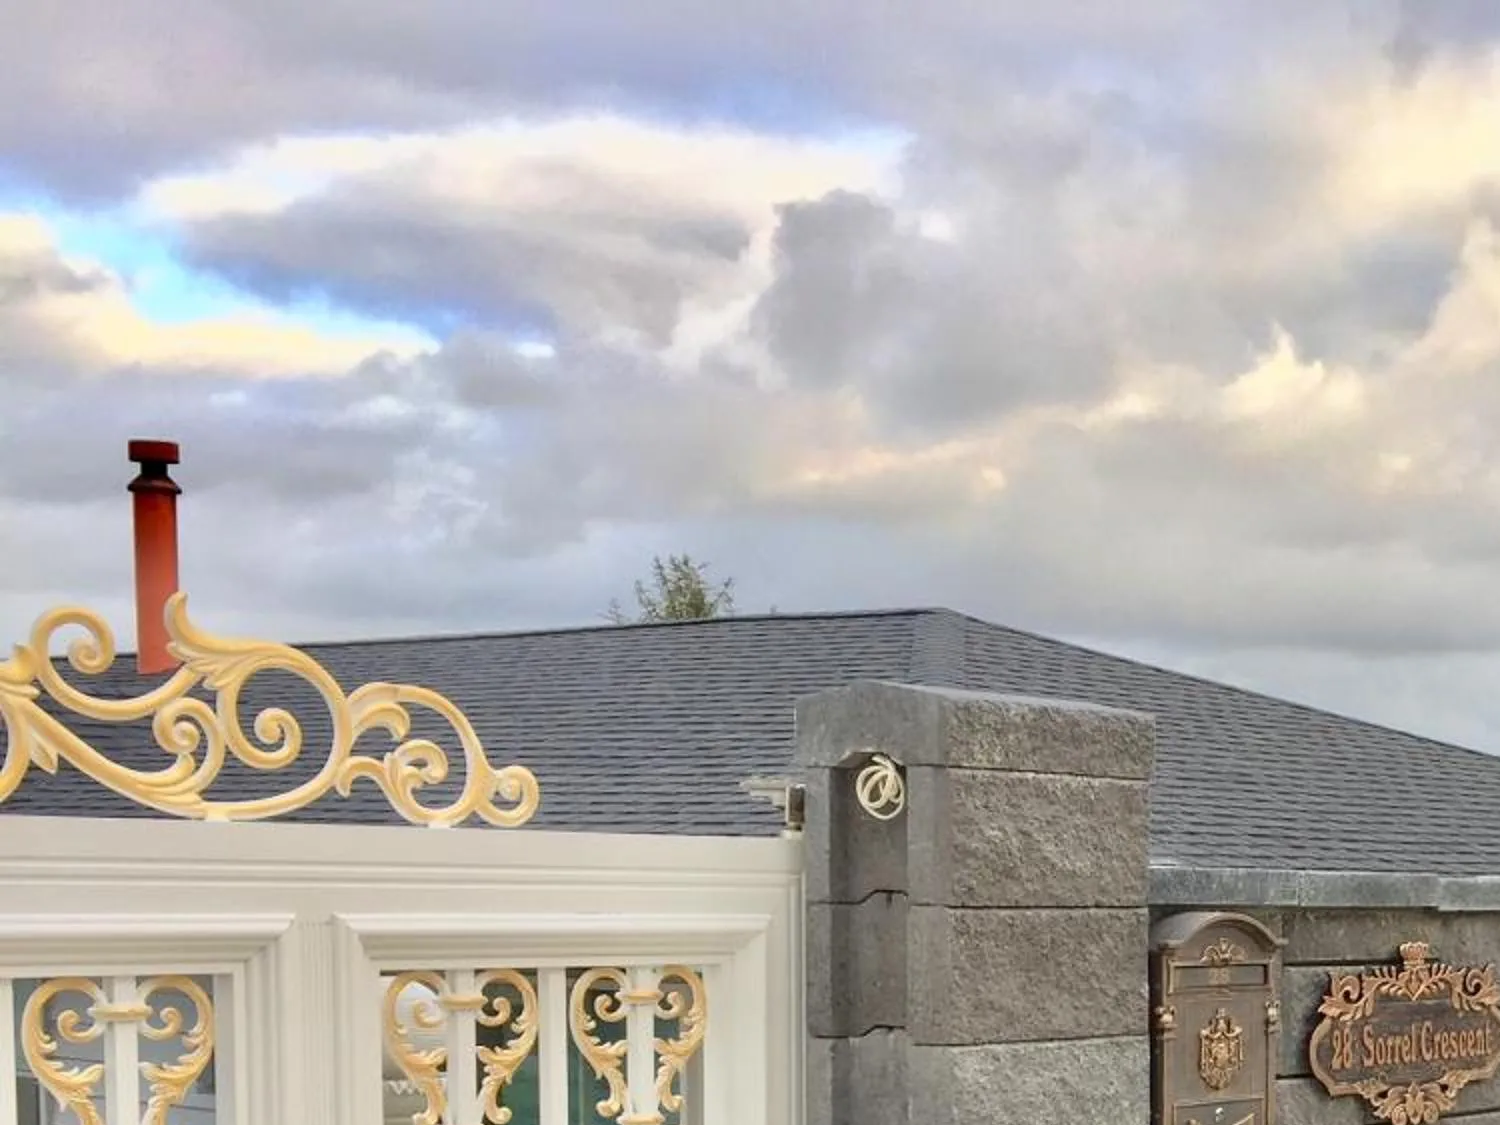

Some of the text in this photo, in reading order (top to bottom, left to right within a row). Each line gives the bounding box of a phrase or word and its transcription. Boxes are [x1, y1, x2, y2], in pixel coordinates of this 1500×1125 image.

[1332, 1020, 1493, 1069] 28 Sorrel Crescent
